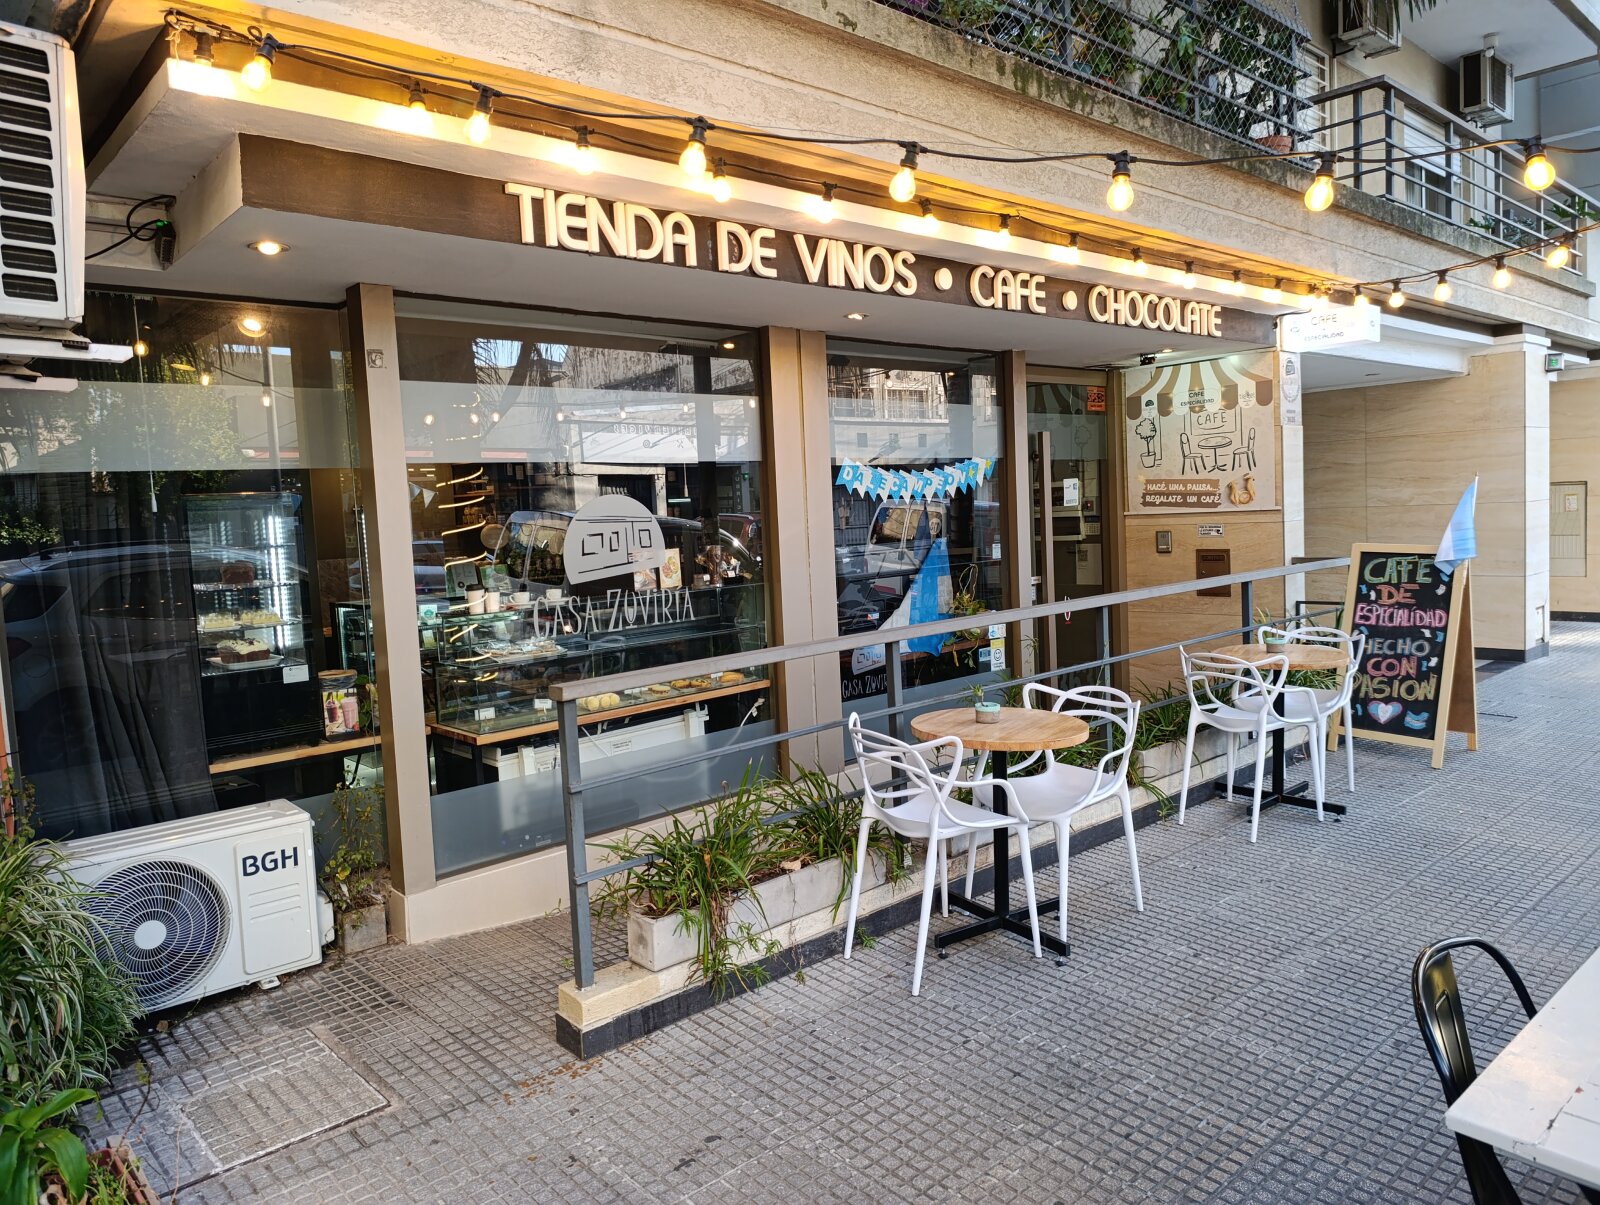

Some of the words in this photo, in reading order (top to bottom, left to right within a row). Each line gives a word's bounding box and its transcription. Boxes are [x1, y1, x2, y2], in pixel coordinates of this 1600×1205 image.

[505, 182, 697, 267] TIENDA
[716, 221, 777, 278] DE
[793, 234, 917, 296] VINOS
[970, 265, 1046, 313] CAFE
[1088, 285, 1222, 337] CHOCOLATE
[1311, 314, 1337, 325] CAFE
[1197, 411, 1227, 425] CAFE
[1376, 583, 1420, 604] DE
[533, 595, 599, 640] CASA
[1364, 637, 1431, 657] HECHO
[1366, 656, 1418, 678] CON
[842, 679, 864, 699] CASA
[242, 846, 298, 876] BGH
